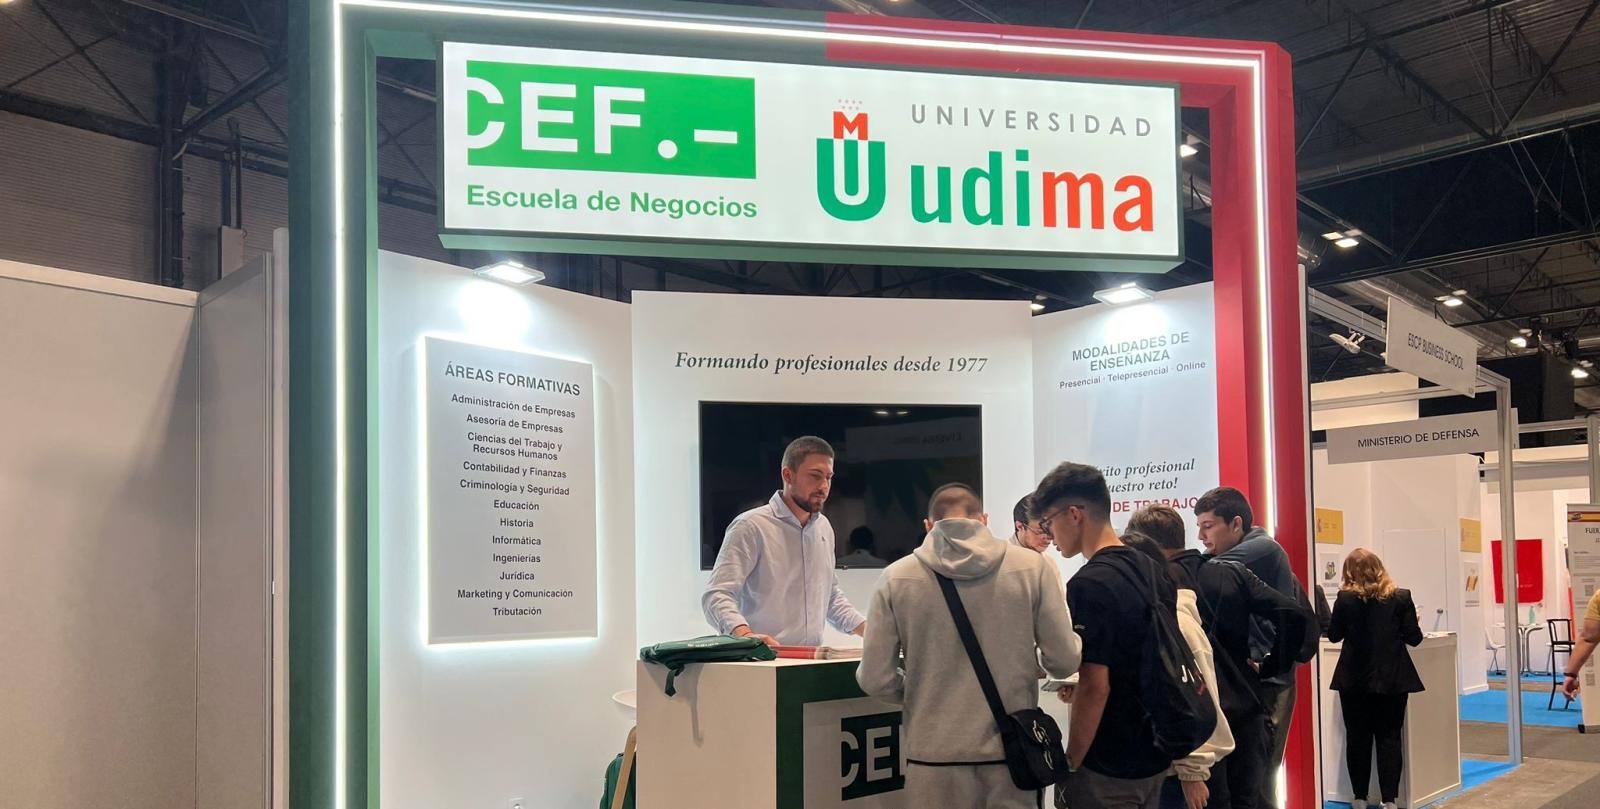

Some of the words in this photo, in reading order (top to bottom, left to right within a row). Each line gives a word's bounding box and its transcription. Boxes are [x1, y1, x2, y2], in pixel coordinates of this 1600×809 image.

[910, 103, 1152, 137] UNIVERSIDAD
[910, 148, 1154, 233] udima
[466, 184, 578, 211] Escuela
[586, 190, 621, 212] de
[630, 191, 758, 219] Negocios
[1072, 335, 1167, 361] MODALIDADES
[1170, 331, 1190, 345] DE
[1407, 332, 1422, 350] ESCP
[1422, 339, 1444, 361] BUSINESS
[1444, 350, 1464, 370] SCHOOL
[674, 351, 769, 370] Formando
[773, 353, 888, 375] profesionales
[893, 355, 941, 372] desde
[947, 356, 988, 372] 1977
[1090, 349, 1171, 372] ENSEÑANZA
[445, 361, 494, 383] ÁREAS
[498, 372, 581, 396] FORMATIVAS
[1059, 375, 1101, 390] Presencial
[1107, 366, 1169, 383] Telepresencial
[1175, 360, 1206, 373] Online
[451, 393, 520, 411] Administración
[522, 403, 533, 413] de
[535, 404, 576, 419] Empresas
[466, 413, 506, 426] Asesoría
[508, 418, 520, 428] de
[521, 420, 564, 434] Empresas
[467, 431, 507, 444] Ciencias
[508, 436, 522, 446] del
[524, 438, 556, 451] Trabajo
[557, 443, 563, 452] y
[1357, 434, 1413, 448] MINISTERIO
[1415, 433, 1429, 443] DE
[1432, 428, 1480, 441] DEFENSA
[473, 443, 516, 456] Recursos
[518, 448, 558, 461] Humanos
[463, 461, 520, 474] Contabilidad
[522, 467, 528, 477] y
[529, 467, 567, 479] Finanzas
[1124, 458, 1195, 479] profesional
[460, 479, 518, 493] Criminología
[519, 484, 525, 494] y
[527, 484, 570, 496] Seguridad
[1108, 482, 1145, 493] uestro
[1148, 477, 1179, 491] reto!
[493, 499, 540, 511] Educación
[1112, 500, 1130, 513] DE
[500, 517, 534, 528] Historia
[492, 535, 542, 546] Informática
[492, 553, 541, 565] Ingenierías
[499, 571, 535, 581] Jurídica
[457, 588, 503, 600] Marketing
[505, 591, 511, 600] y
[512, 588, 573, 598] Comunicación
[492, 606, 542, 616] Tributación
